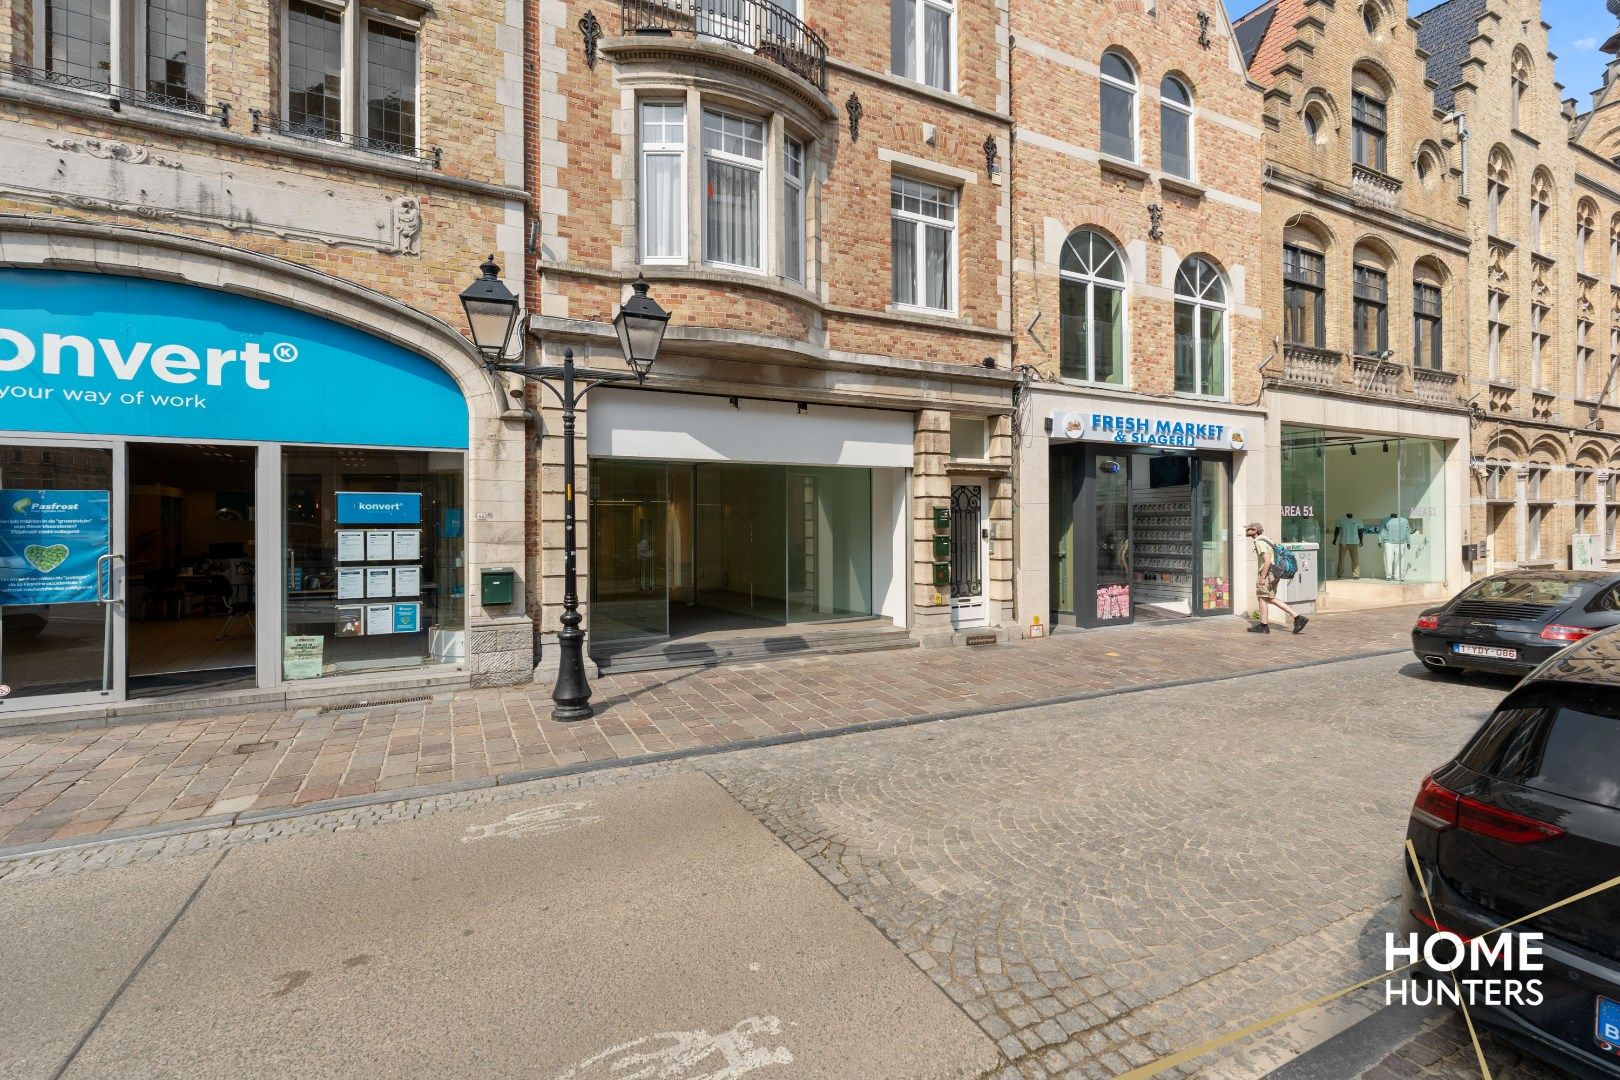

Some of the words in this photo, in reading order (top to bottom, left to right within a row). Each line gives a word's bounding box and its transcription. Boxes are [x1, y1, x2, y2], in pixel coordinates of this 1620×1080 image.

[0, 328, 270, 390] onvert
[62, 388, 111, 405] way
[120, 390, 145, 405] of
[151, 394, 206, 408] work
[1092, 414, 1149, 432] FRESH
[1156, 420, 1224, 438] MARKET
[1114, 430, 1126, 443] &
[1131, 432, 1195, 447] SLAGERIJ
[359, 502, 400, 510] konvert
[1281, 506, 1301, 517] AREA
[1303, 506, 1314, 517] 51
[1605, 1023, 1619, 1040] B
